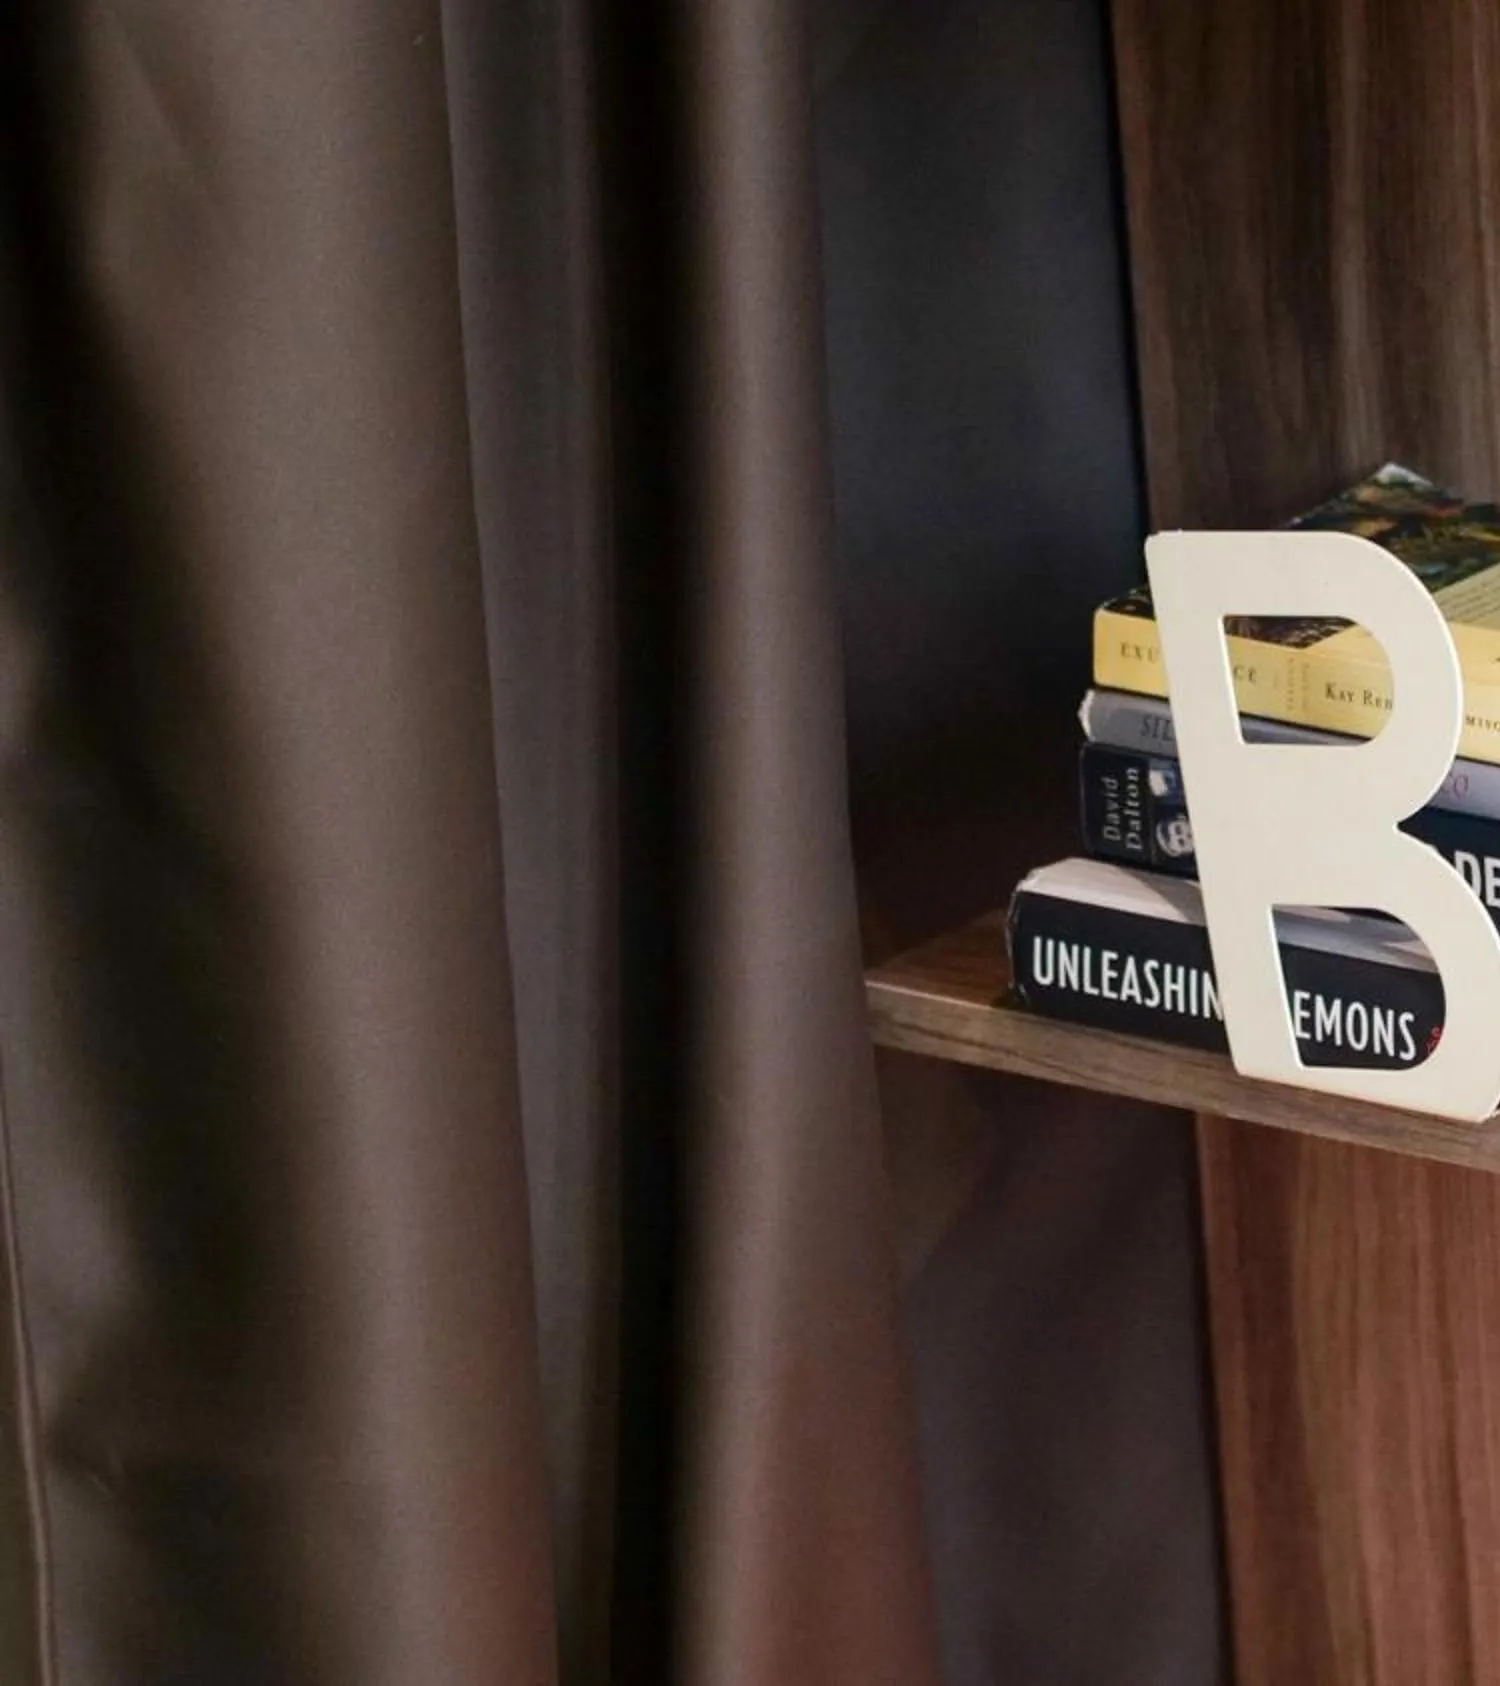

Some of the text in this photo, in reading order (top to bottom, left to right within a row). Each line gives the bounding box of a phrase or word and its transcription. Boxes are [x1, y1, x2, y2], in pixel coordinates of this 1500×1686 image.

[1101, 775, 1121, 841] David
[1124, 767, 1143, 850] Dalton
[1033, 935, 1417, 1062] UNLEASHIN EMONS
